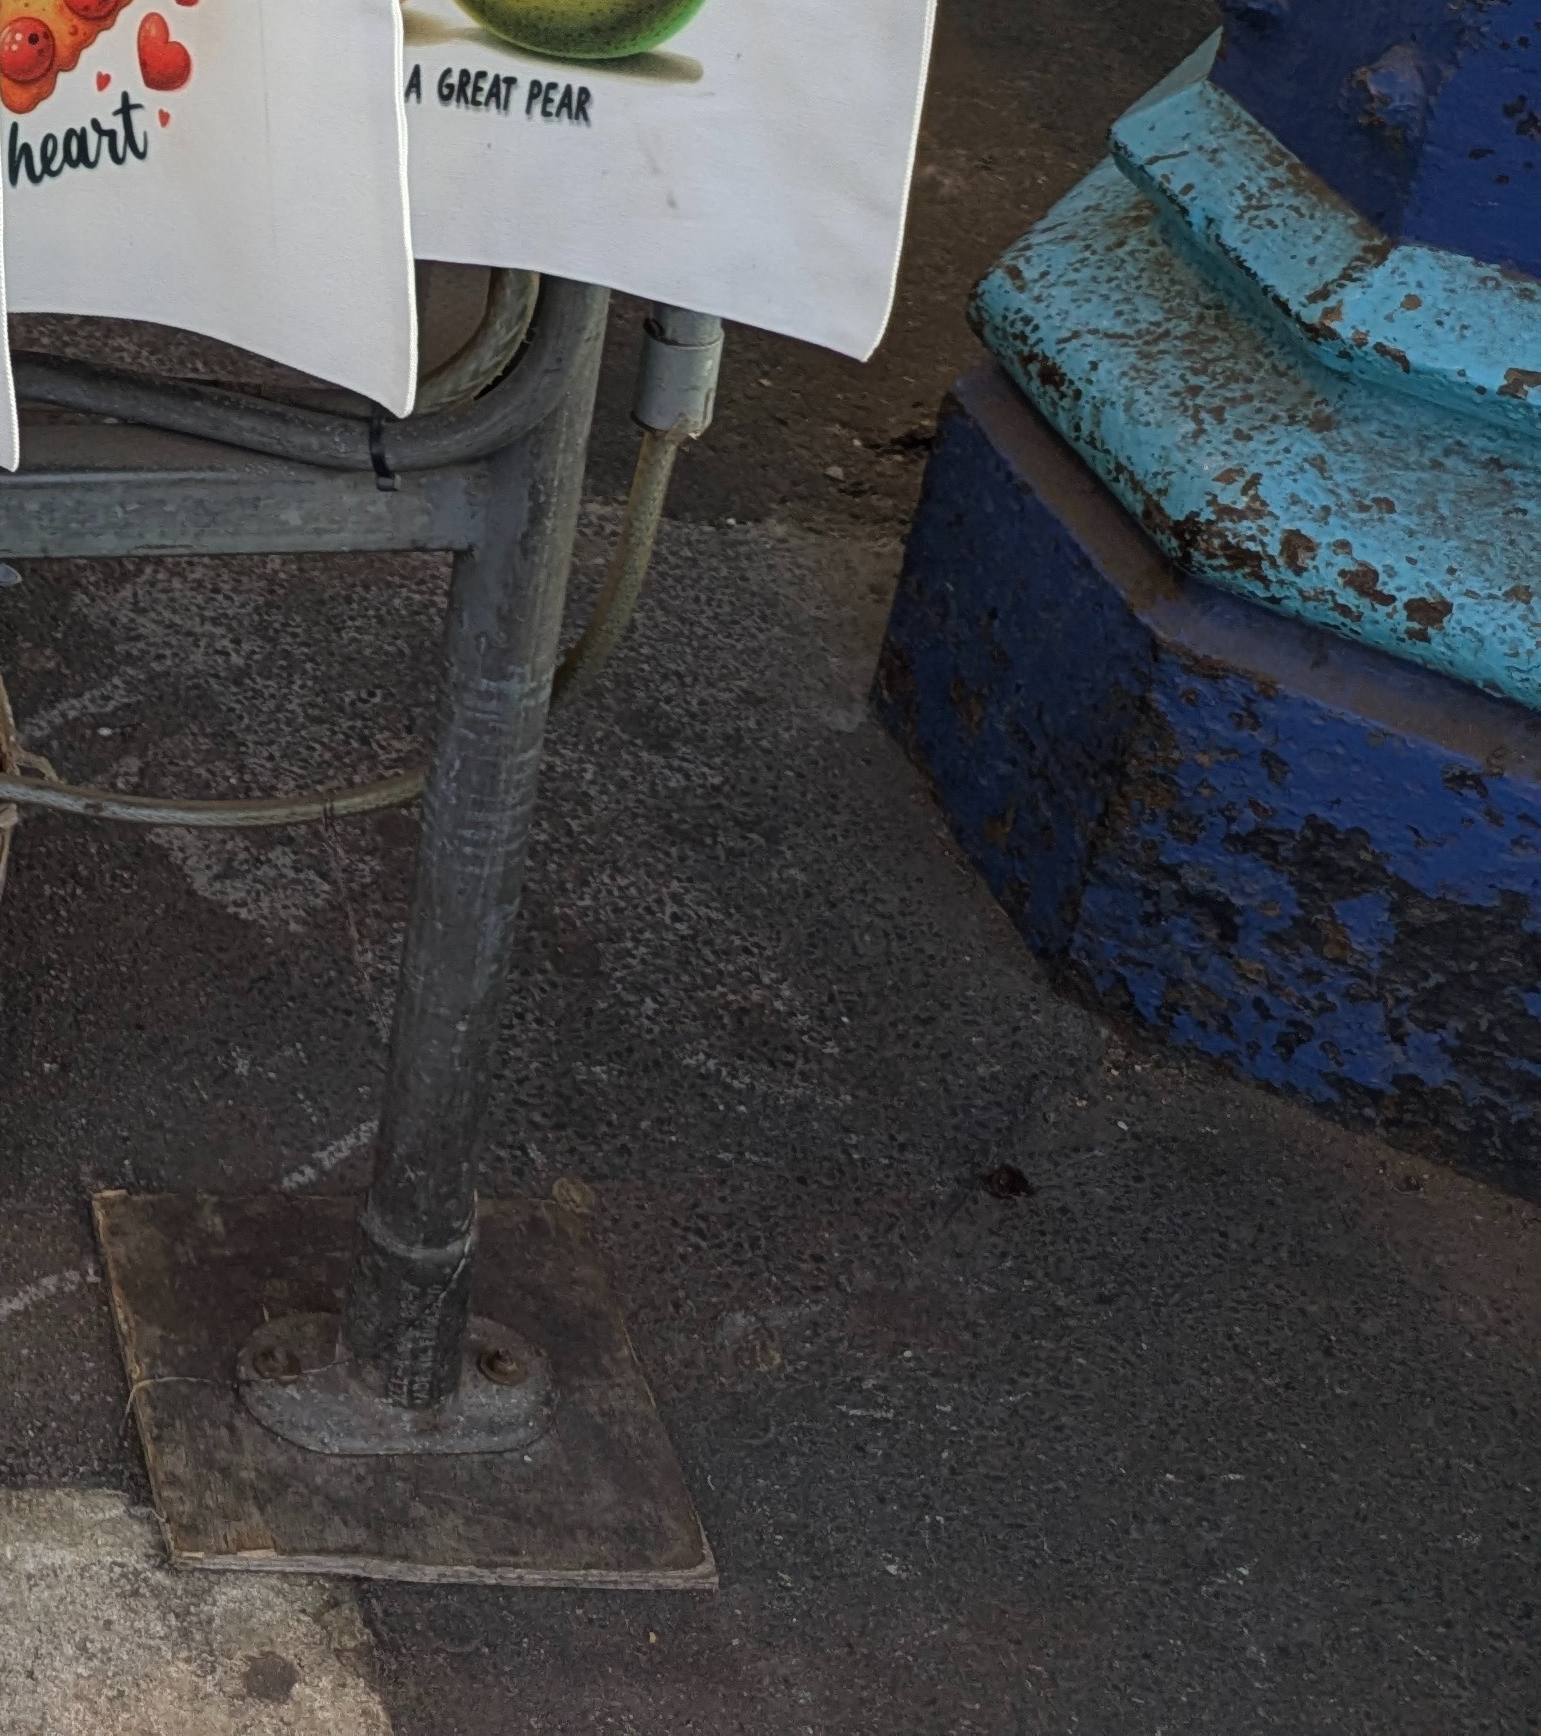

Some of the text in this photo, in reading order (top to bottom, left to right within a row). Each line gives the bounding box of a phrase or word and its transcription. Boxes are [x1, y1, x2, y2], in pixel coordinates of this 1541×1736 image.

[404, 63, 592, 126] A GREAT PEAR
[8, 90, 149, 187] heart
